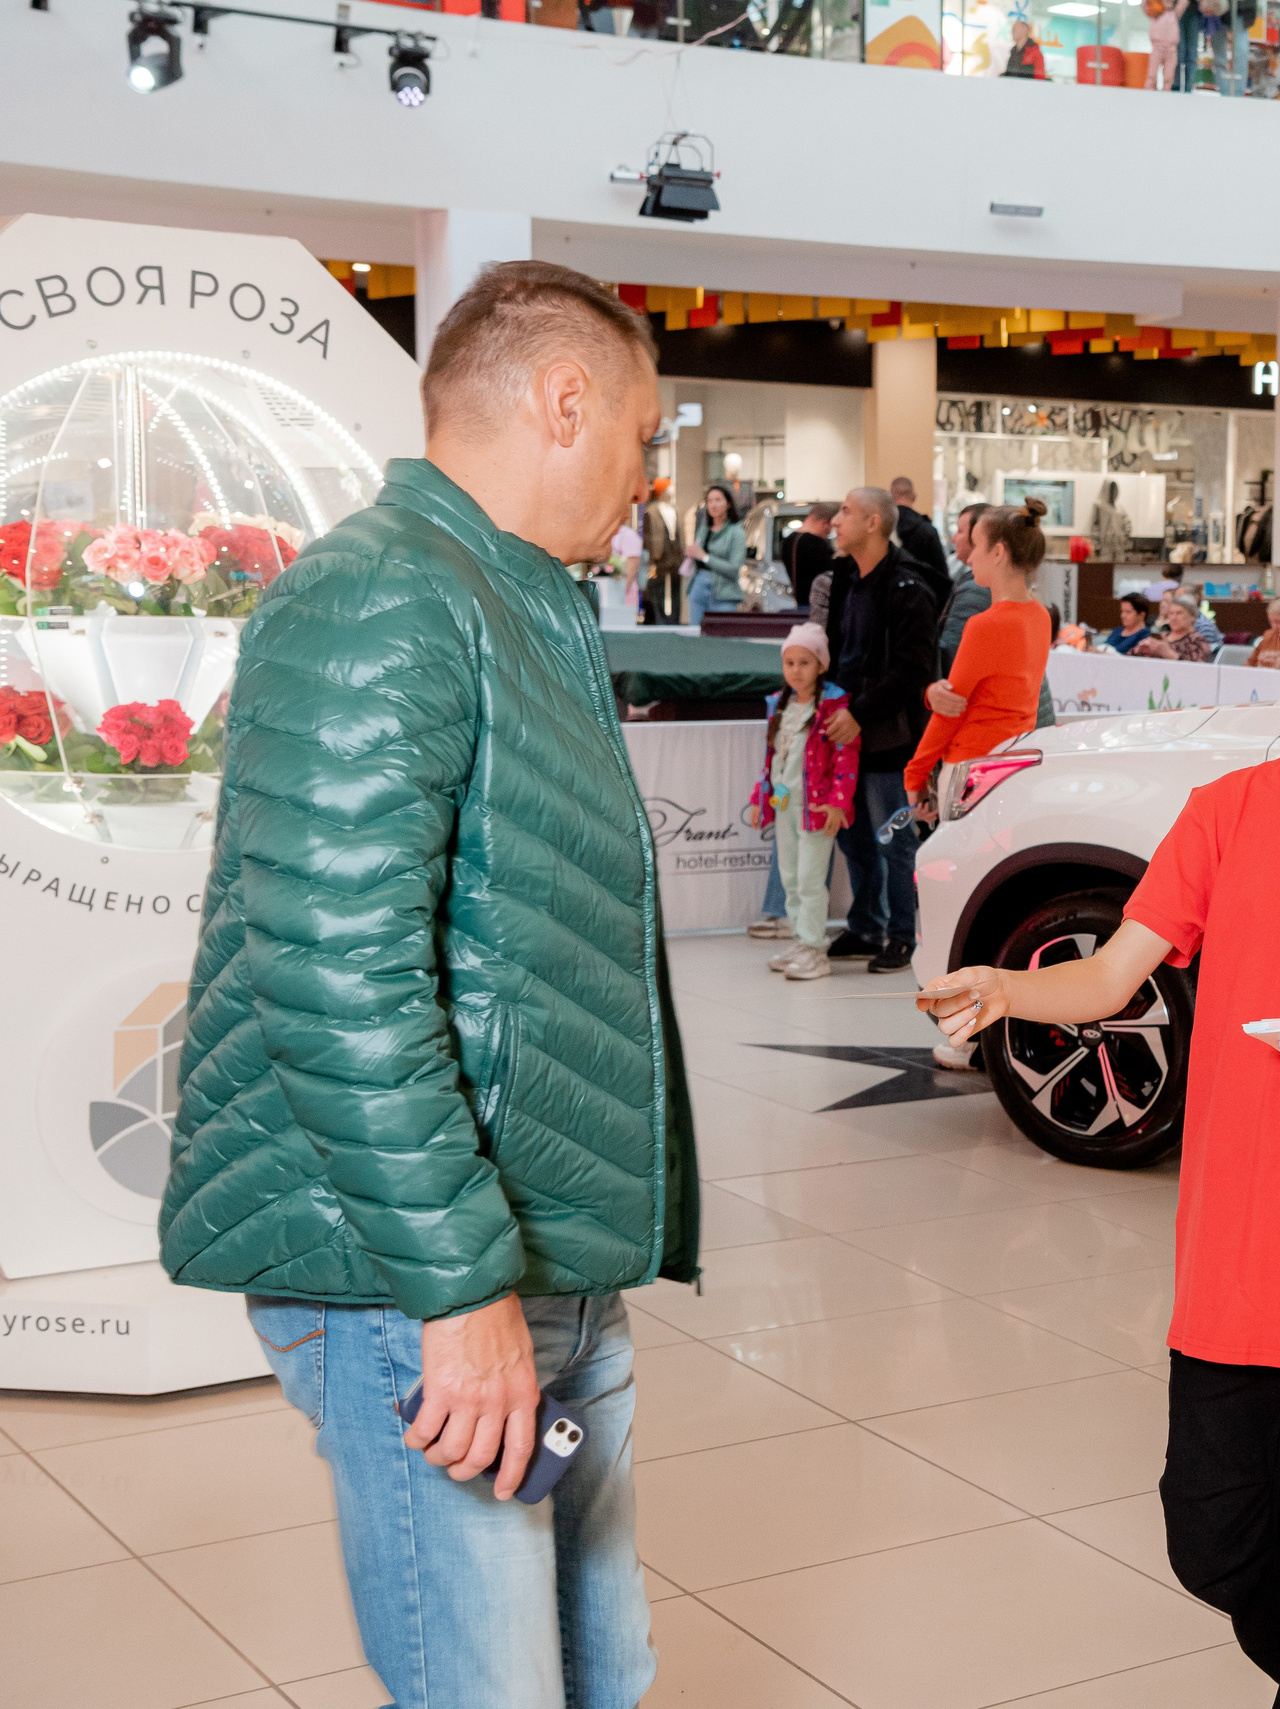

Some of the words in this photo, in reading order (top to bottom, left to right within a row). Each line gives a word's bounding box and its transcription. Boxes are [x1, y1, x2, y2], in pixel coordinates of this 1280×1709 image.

[0, 265, 166, 331] СВОЯ
[189, 269, 331, 360] РОЗА
[2, 1313, 130, 1337] yrose.ru
